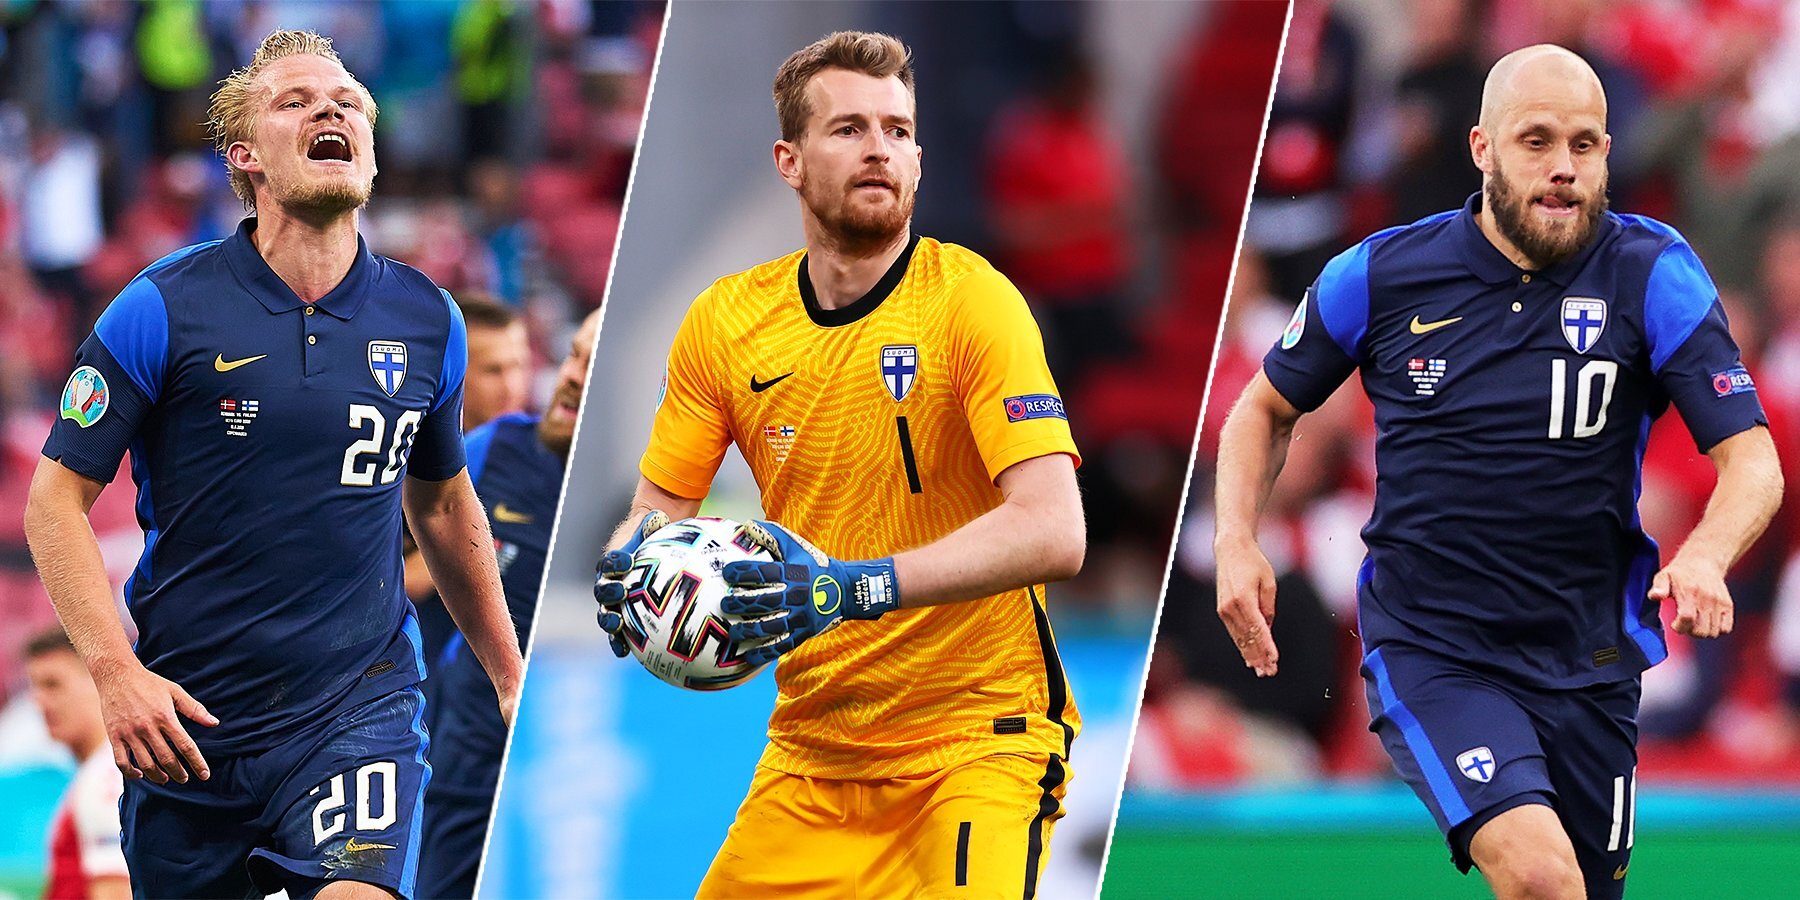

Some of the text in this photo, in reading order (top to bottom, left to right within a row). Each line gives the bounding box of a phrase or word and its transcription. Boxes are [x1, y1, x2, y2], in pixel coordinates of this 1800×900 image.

[1548, 359, 1618, 439] 10
[340, 404, 422, 487] 20
[896, 416, 923, 494] 1
[854, 580, 863, 605] Lukas
[309, 761, 397, 847] 20
[955, 821, 972, 887] 1
